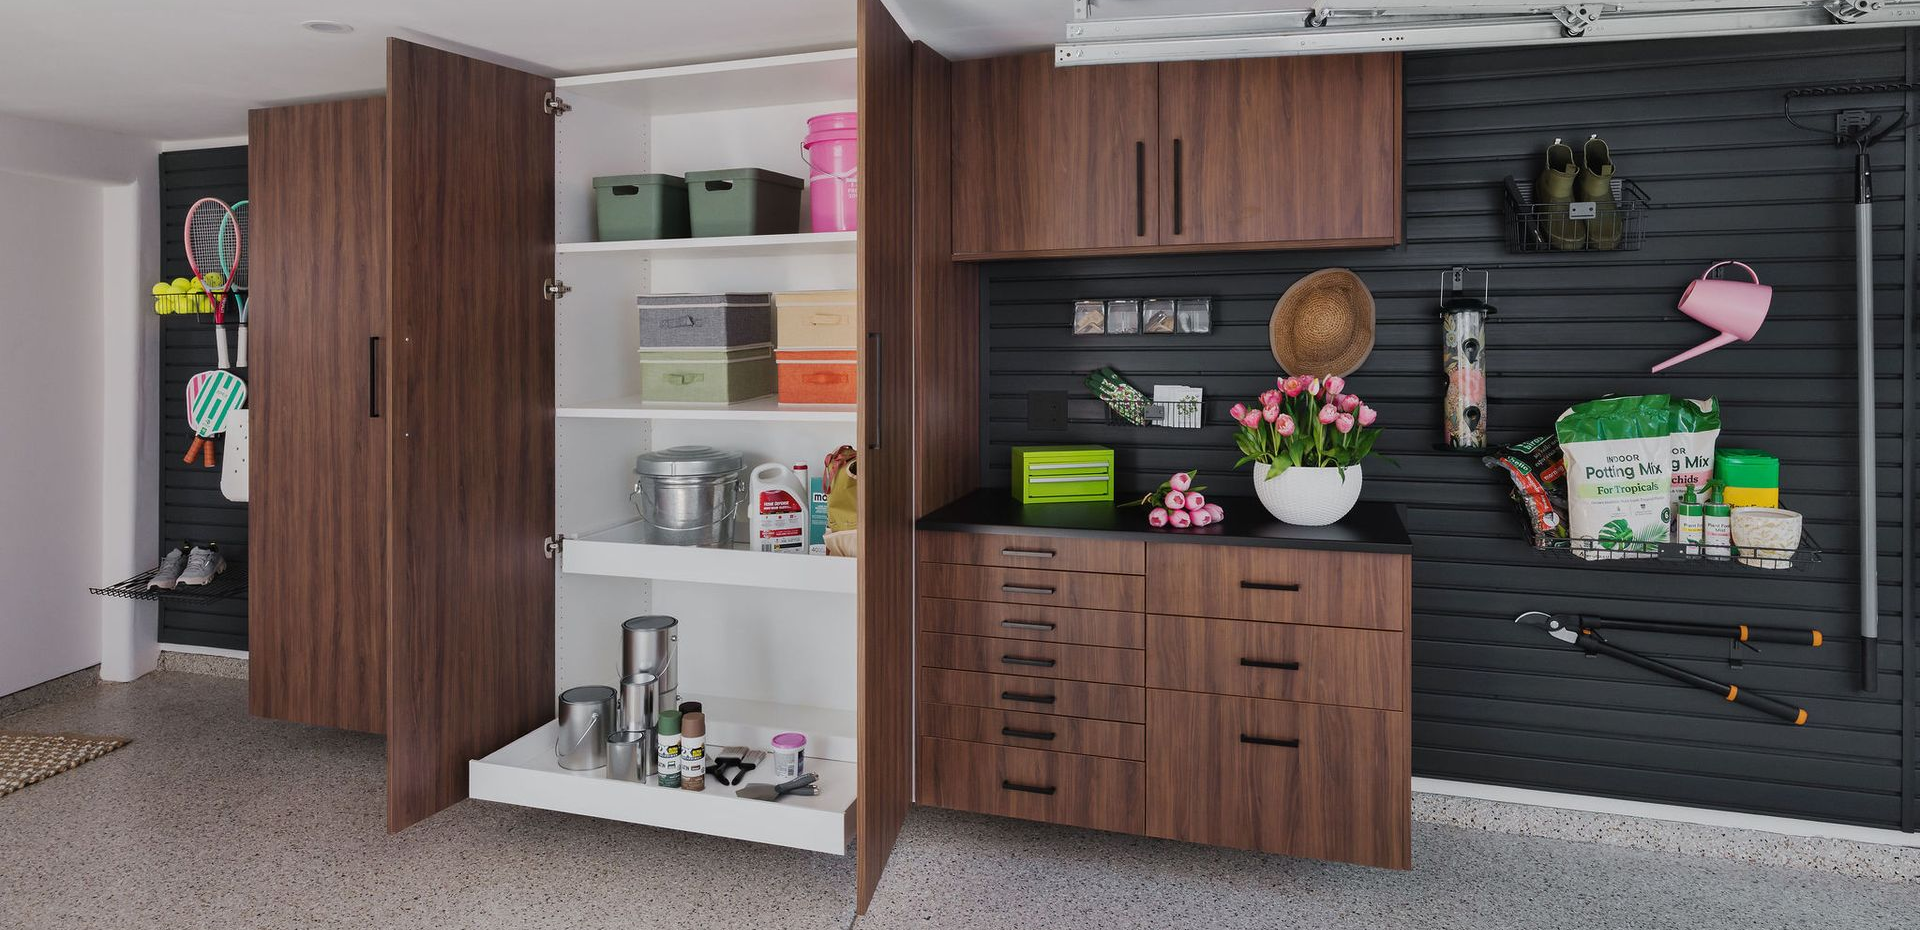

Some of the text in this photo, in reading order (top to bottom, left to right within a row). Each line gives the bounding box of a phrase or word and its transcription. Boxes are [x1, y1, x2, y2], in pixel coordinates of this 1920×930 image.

[1606, 454, 1640, 463] INDOOR
[1685, 456, 1710, 469] Mix
[1586, 462, 1663, 480] Potting Mix
[1597, 486, 1613, 495] For
[1614, 482, 1659, 494] Tropicals
